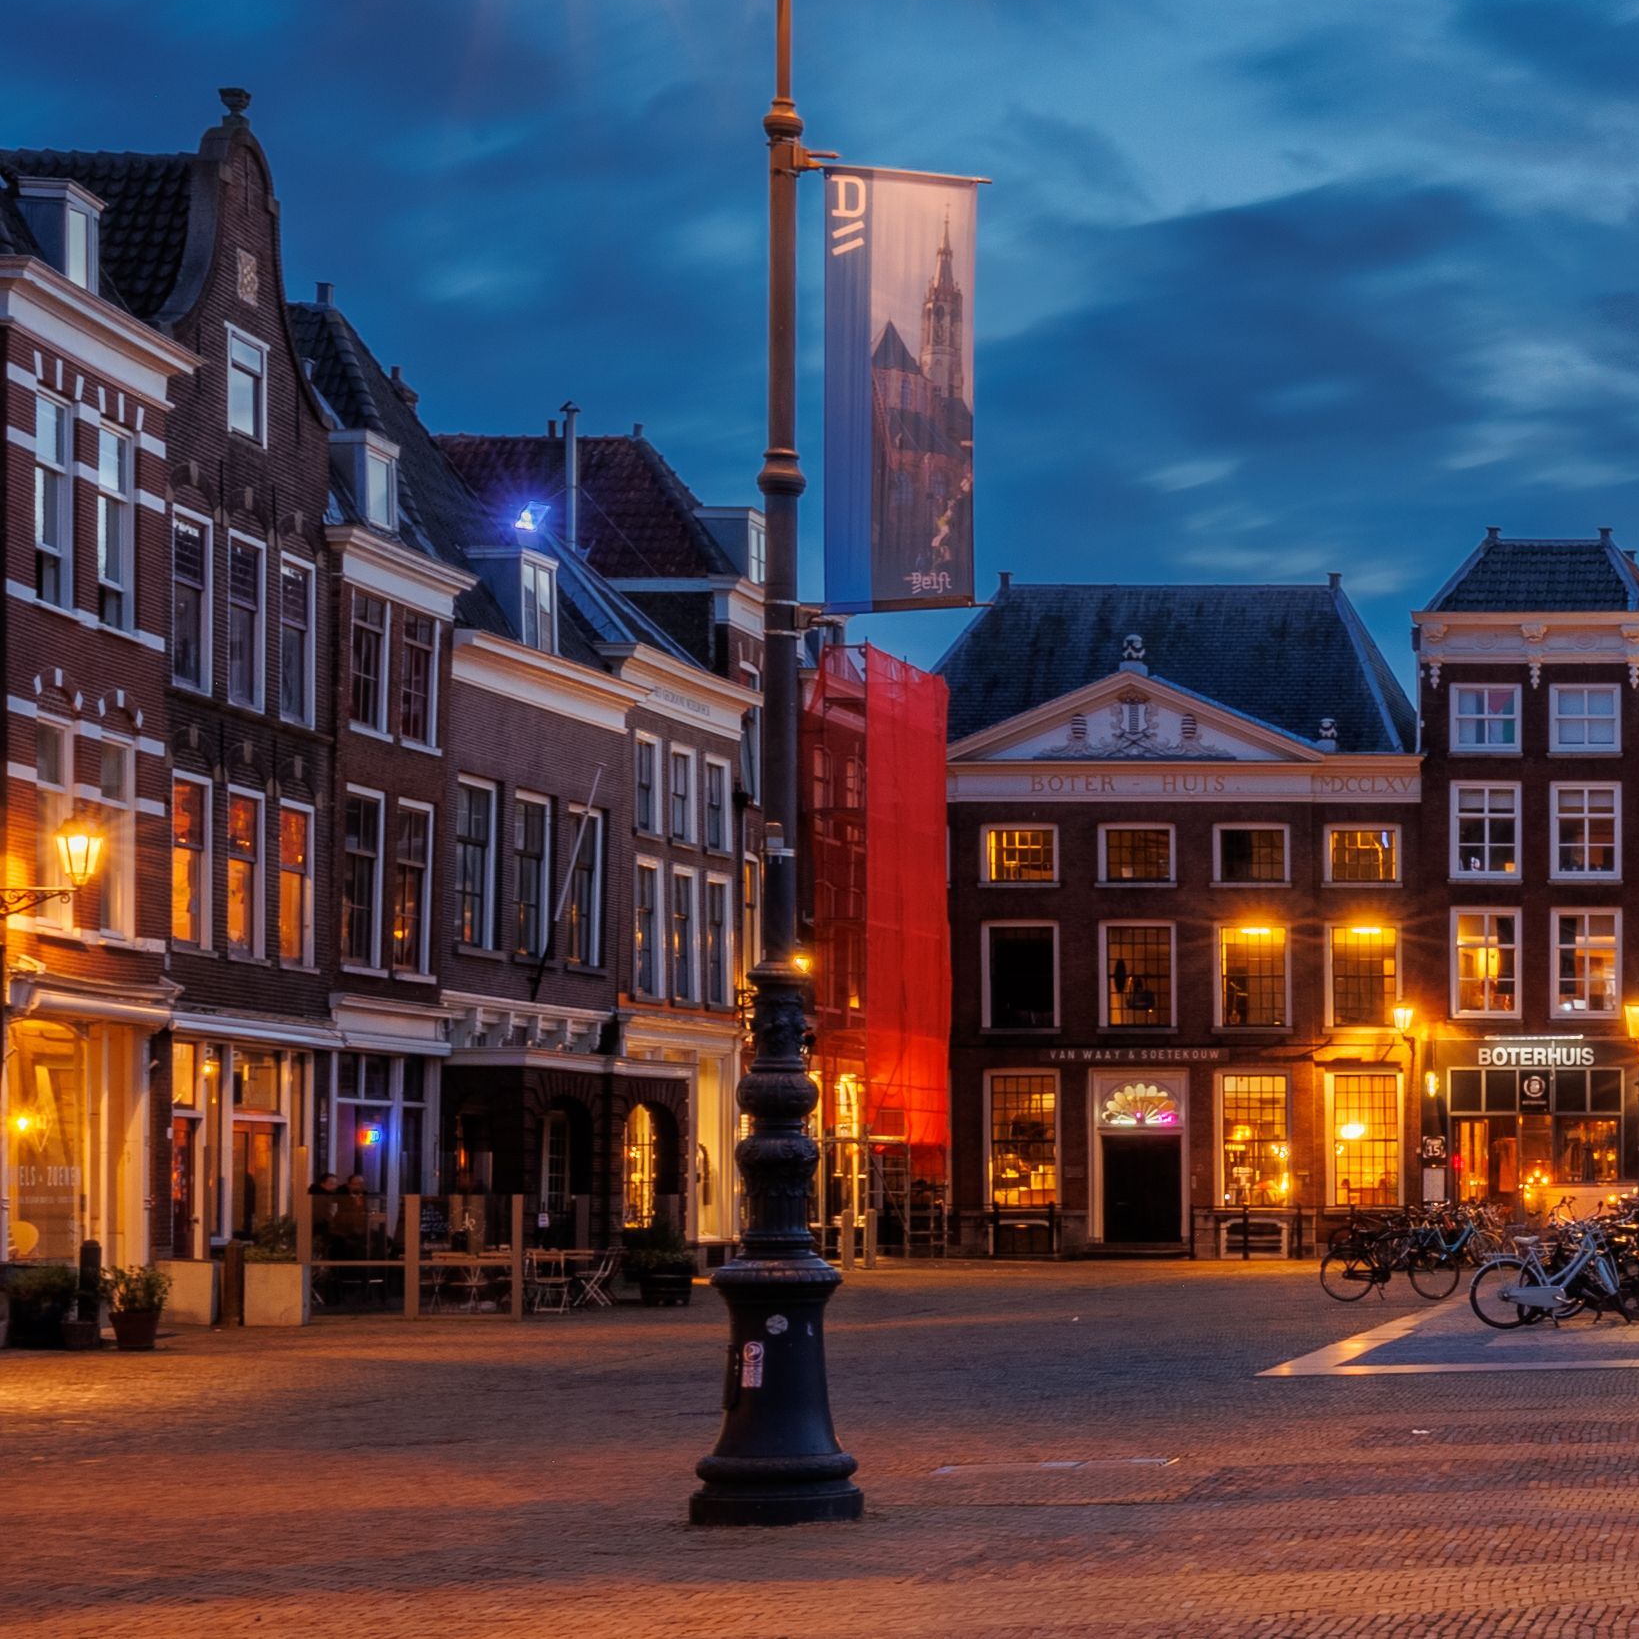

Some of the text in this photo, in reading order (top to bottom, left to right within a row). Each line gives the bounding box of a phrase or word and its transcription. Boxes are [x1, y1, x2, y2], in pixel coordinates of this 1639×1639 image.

[911, 571, 953, 594] Delft
[1031, 776, 1116, 792] BOTER
[1320, 776, 1413, 792] MDCCLXV
[1050, 1050, 1075, 1059] VAN
[1083, 1050, 1120, 1059] WAAY
[1141, 1050, 1220, 1059] SOETEKOUW
[1478, 1048, 1595, 1065] BOTERHUIS
